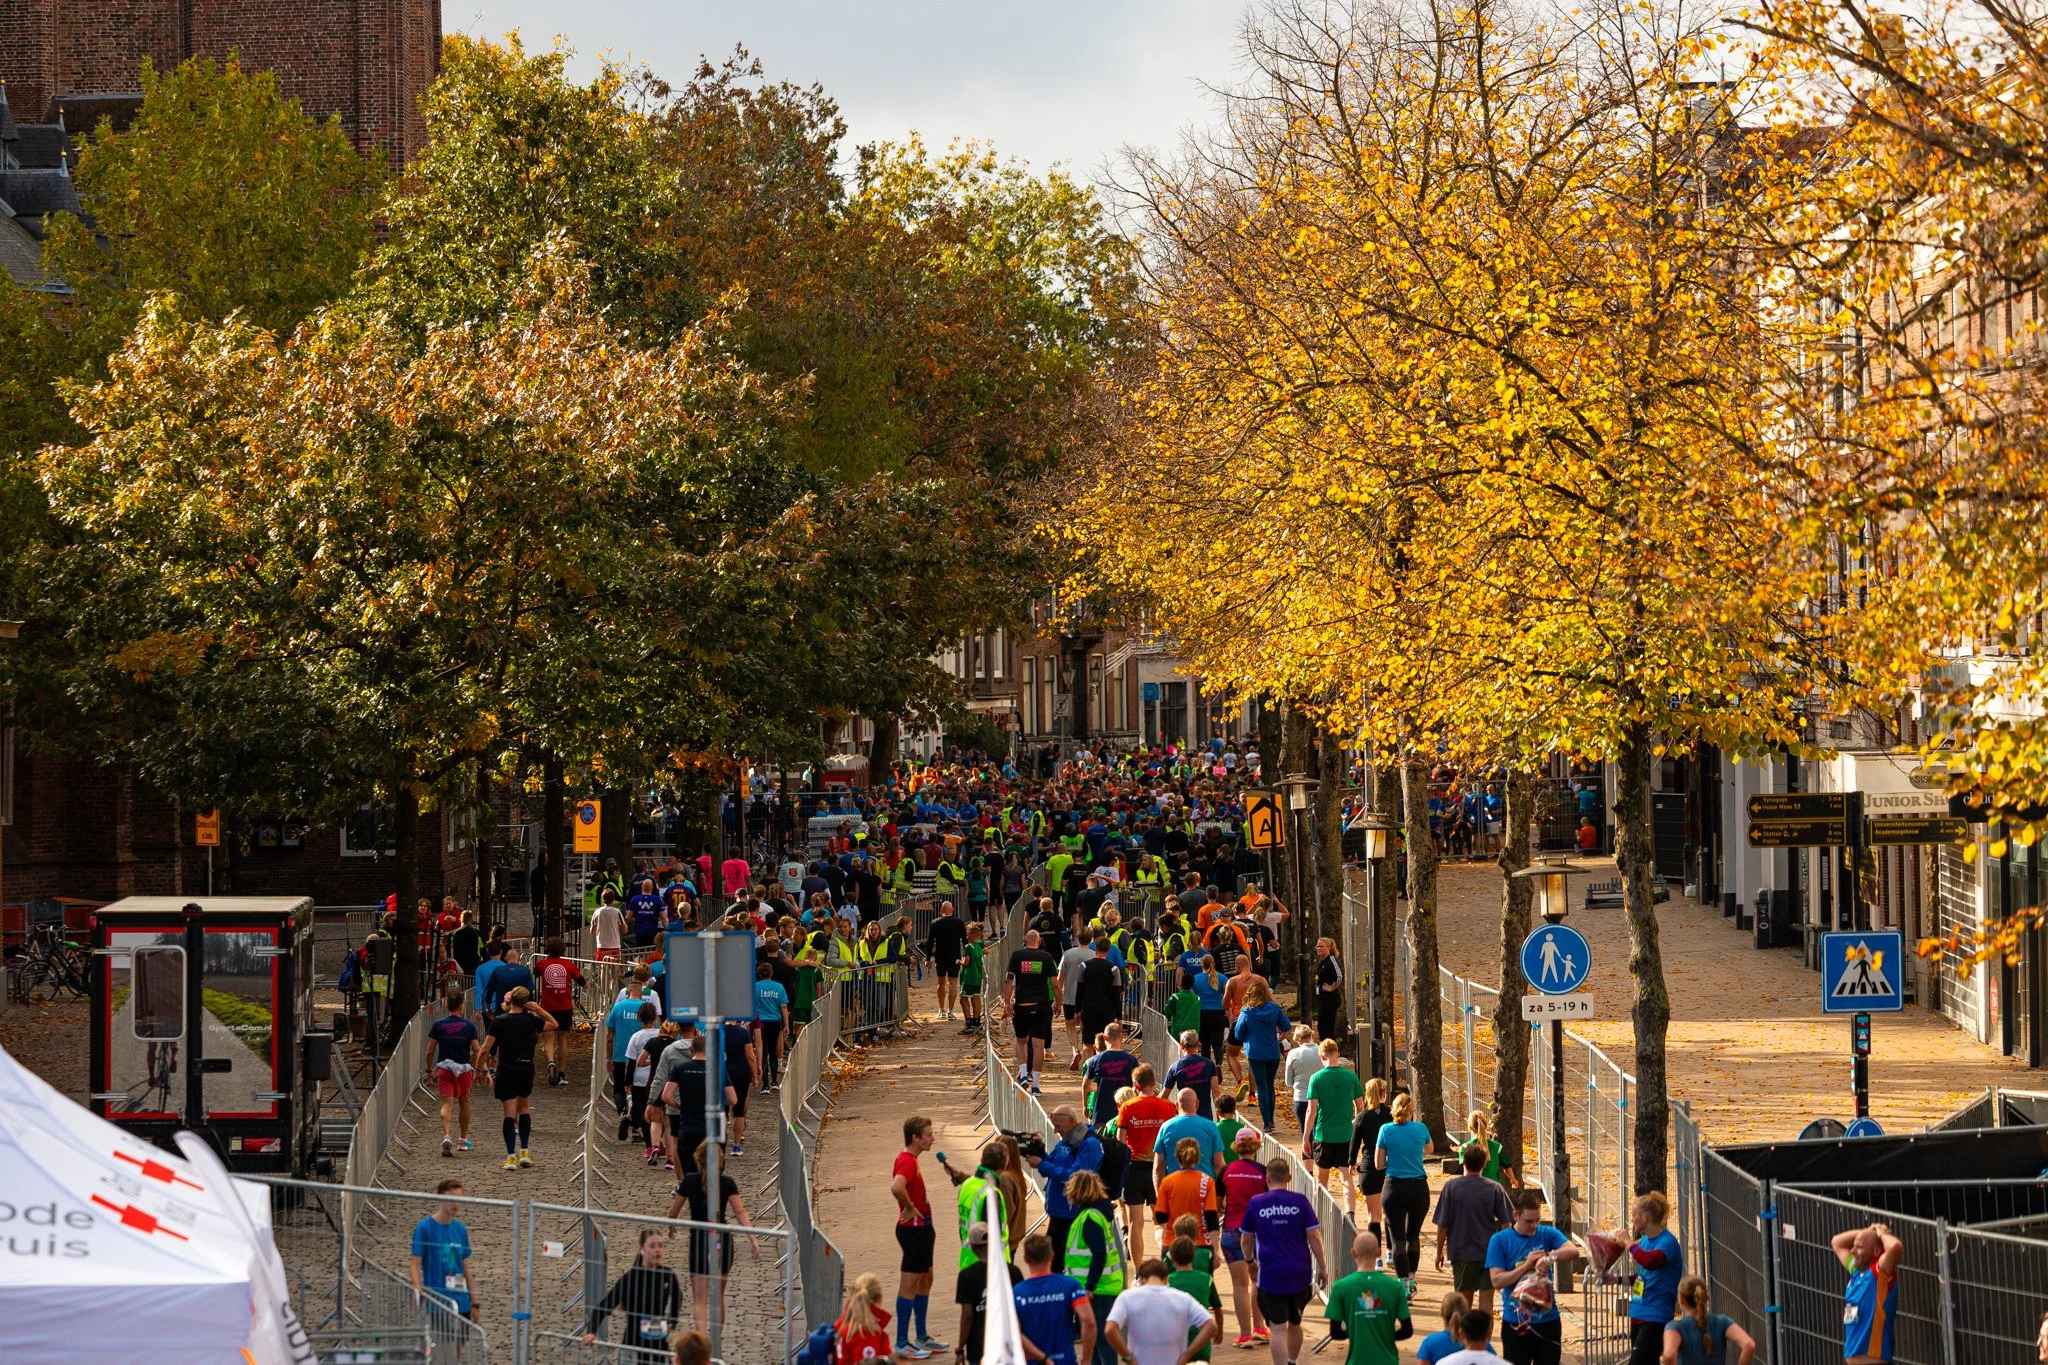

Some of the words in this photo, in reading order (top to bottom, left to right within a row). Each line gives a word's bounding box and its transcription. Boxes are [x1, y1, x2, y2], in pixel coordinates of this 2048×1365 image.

[1762, 796, 1787, 804] Synagoge
[1863, 794, 1922, 808] JUNIOR
[1923, 792, 1948, 806] SH
[1258, 818, 1273, 837] A
[1762, 823, 1788, 831] Groninger
[760, 989, 779, 999] Lentis
[1529, 1005, 1543, 1013] za
[1548, 1001, 1576, 1012] 5-19
[1581, 1001, 1588, 1011] h
[208, 1024, 272, 1033] SportsCom.nl
[1259, 1205, 1299, 1219] ophtec
[0, 1233, 90, 1259] uis
